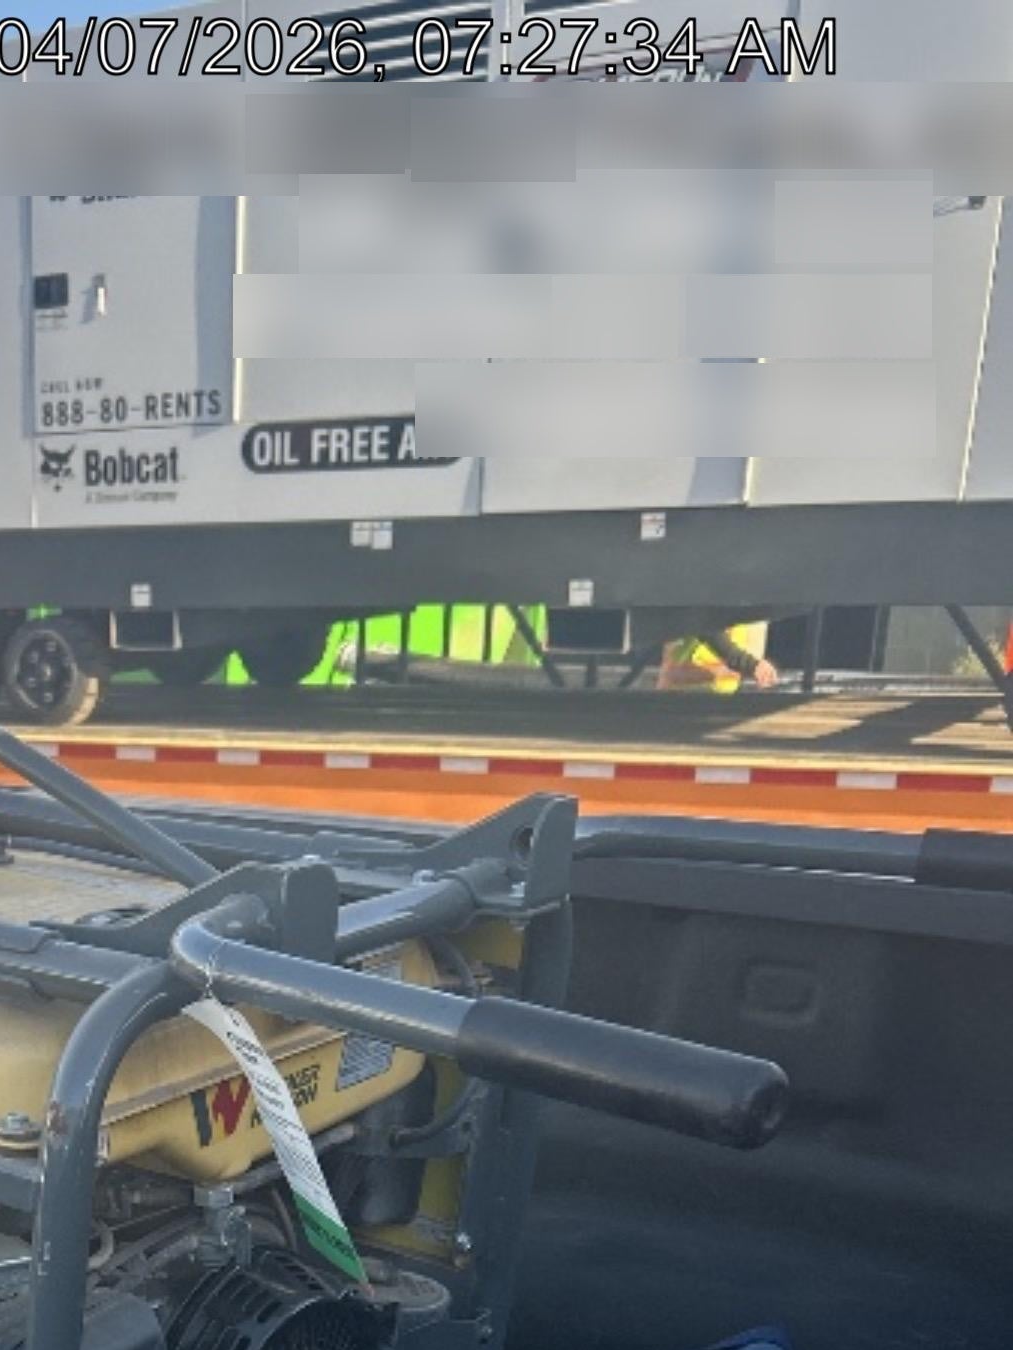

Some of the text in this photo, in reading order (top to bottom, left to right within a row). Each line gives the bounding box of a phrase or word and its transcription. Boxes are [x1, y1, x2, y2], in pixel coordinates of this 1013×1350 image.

[42, 389, 223, 427] 888-80-RENTS
[252, 429, 299, 466] OIL
[310, 424, 390, 463] FREE
[85, 447, 179, 487] Bobcat
